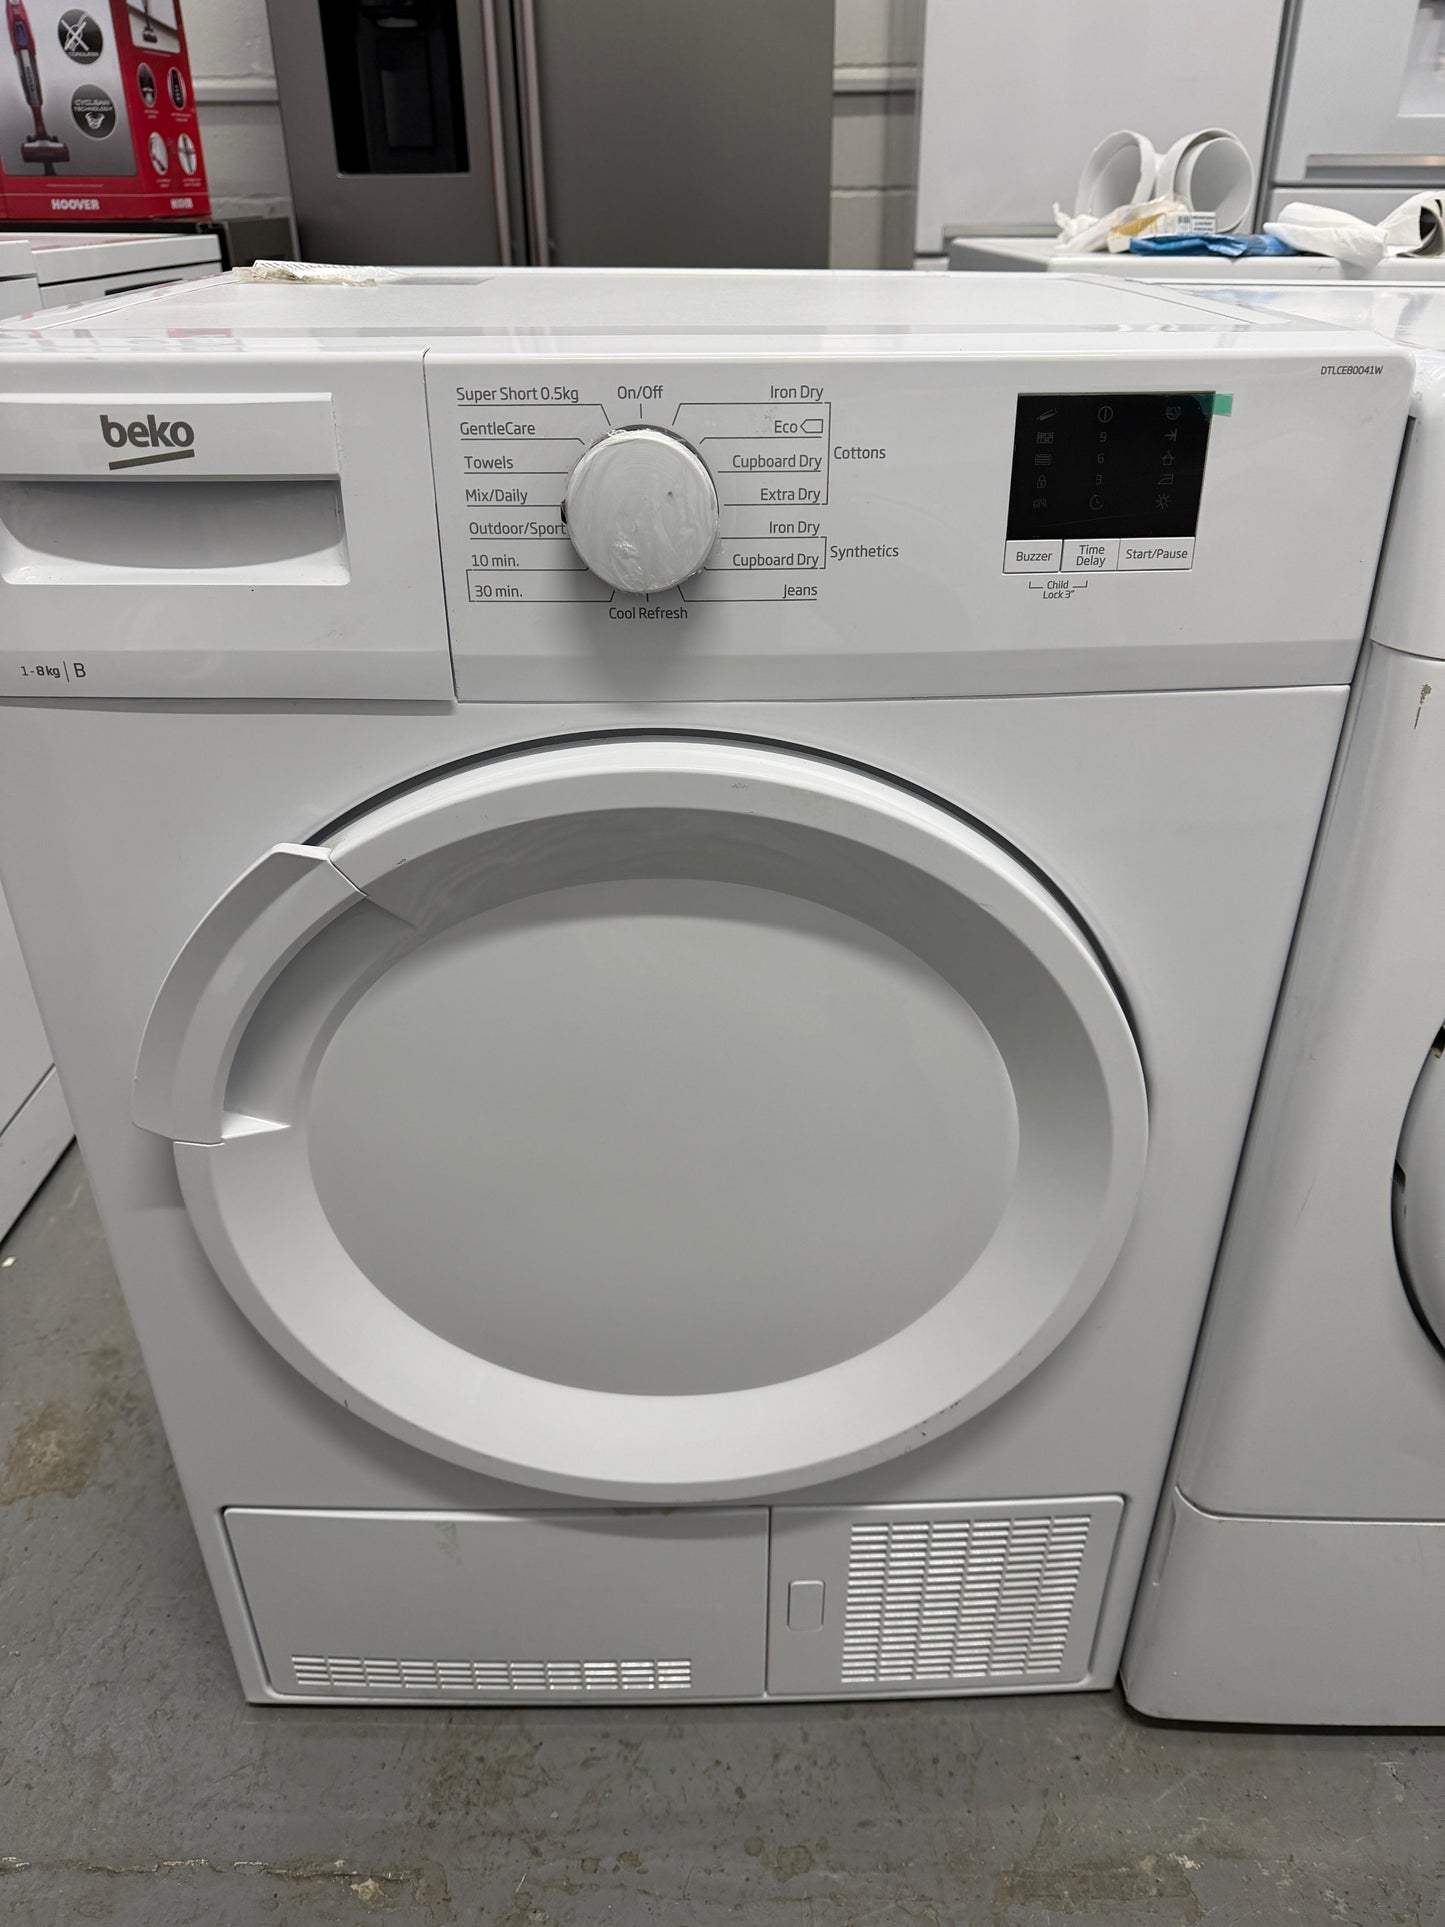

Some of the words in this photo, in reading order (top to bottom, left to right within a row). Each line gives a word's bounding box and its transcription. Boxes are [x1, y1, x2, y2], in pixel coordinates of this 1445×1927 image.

[51, 198, 100, 210] HOOVER
[456, 387, 497, 403] Super
[500, 387, 537, 400] Short
[541, 387, 579, 403] 0.5kg
[617, 385, 663, 400] On/Off
[770, 385, 797, 398] Iron
[800, 385, 823, 402] Dry
[100, 415, 194, 447] beko
[460, 422, 535, 435] GentleCare
[774, 420, 798, 433] Eco
[834, 446, 886, 459] Cottons
[464, 456, 514, 469] Towels
[733, 455, 796, 471] Cupboard
[799, 454, 822, 471] Dry
[465, 489, 528, 504] Mix/Daily
[761, 488, 795, 501] Extra
[798, 488, 821, 504] Dry
[469, 522, 566, 537] Outdoor/Sport
[770, 521, 795, 534] Iron
[798, 521, 820, 537] Dry
[830, 545, 899, 561] Synthetics
[1079, 544, 1105, 555] Time
[1125, 548, 1188, 560] Start/Pause
[471, 554, 488, 567] 10
[492, 554, 519, 567] min.
[733, 553, 794, 570] Cupboard
[797, 553, 819, 570] Dry
[1016, 551, 1052, 562] Buzzer
[1076, 555, 1106, 567] Delay
[475, 585, 492, 597] 30
[495, 585, 523, 597] min.
[1047, 580, 1069, 589] Child
[783, 584, 818, 599] Jeans
[1043, 590, 1063, 599] Lock
[609, 608, 635, 619] Cool
[639, 608, 688, 619] Refresh
[74, 663, 86, 678] B
